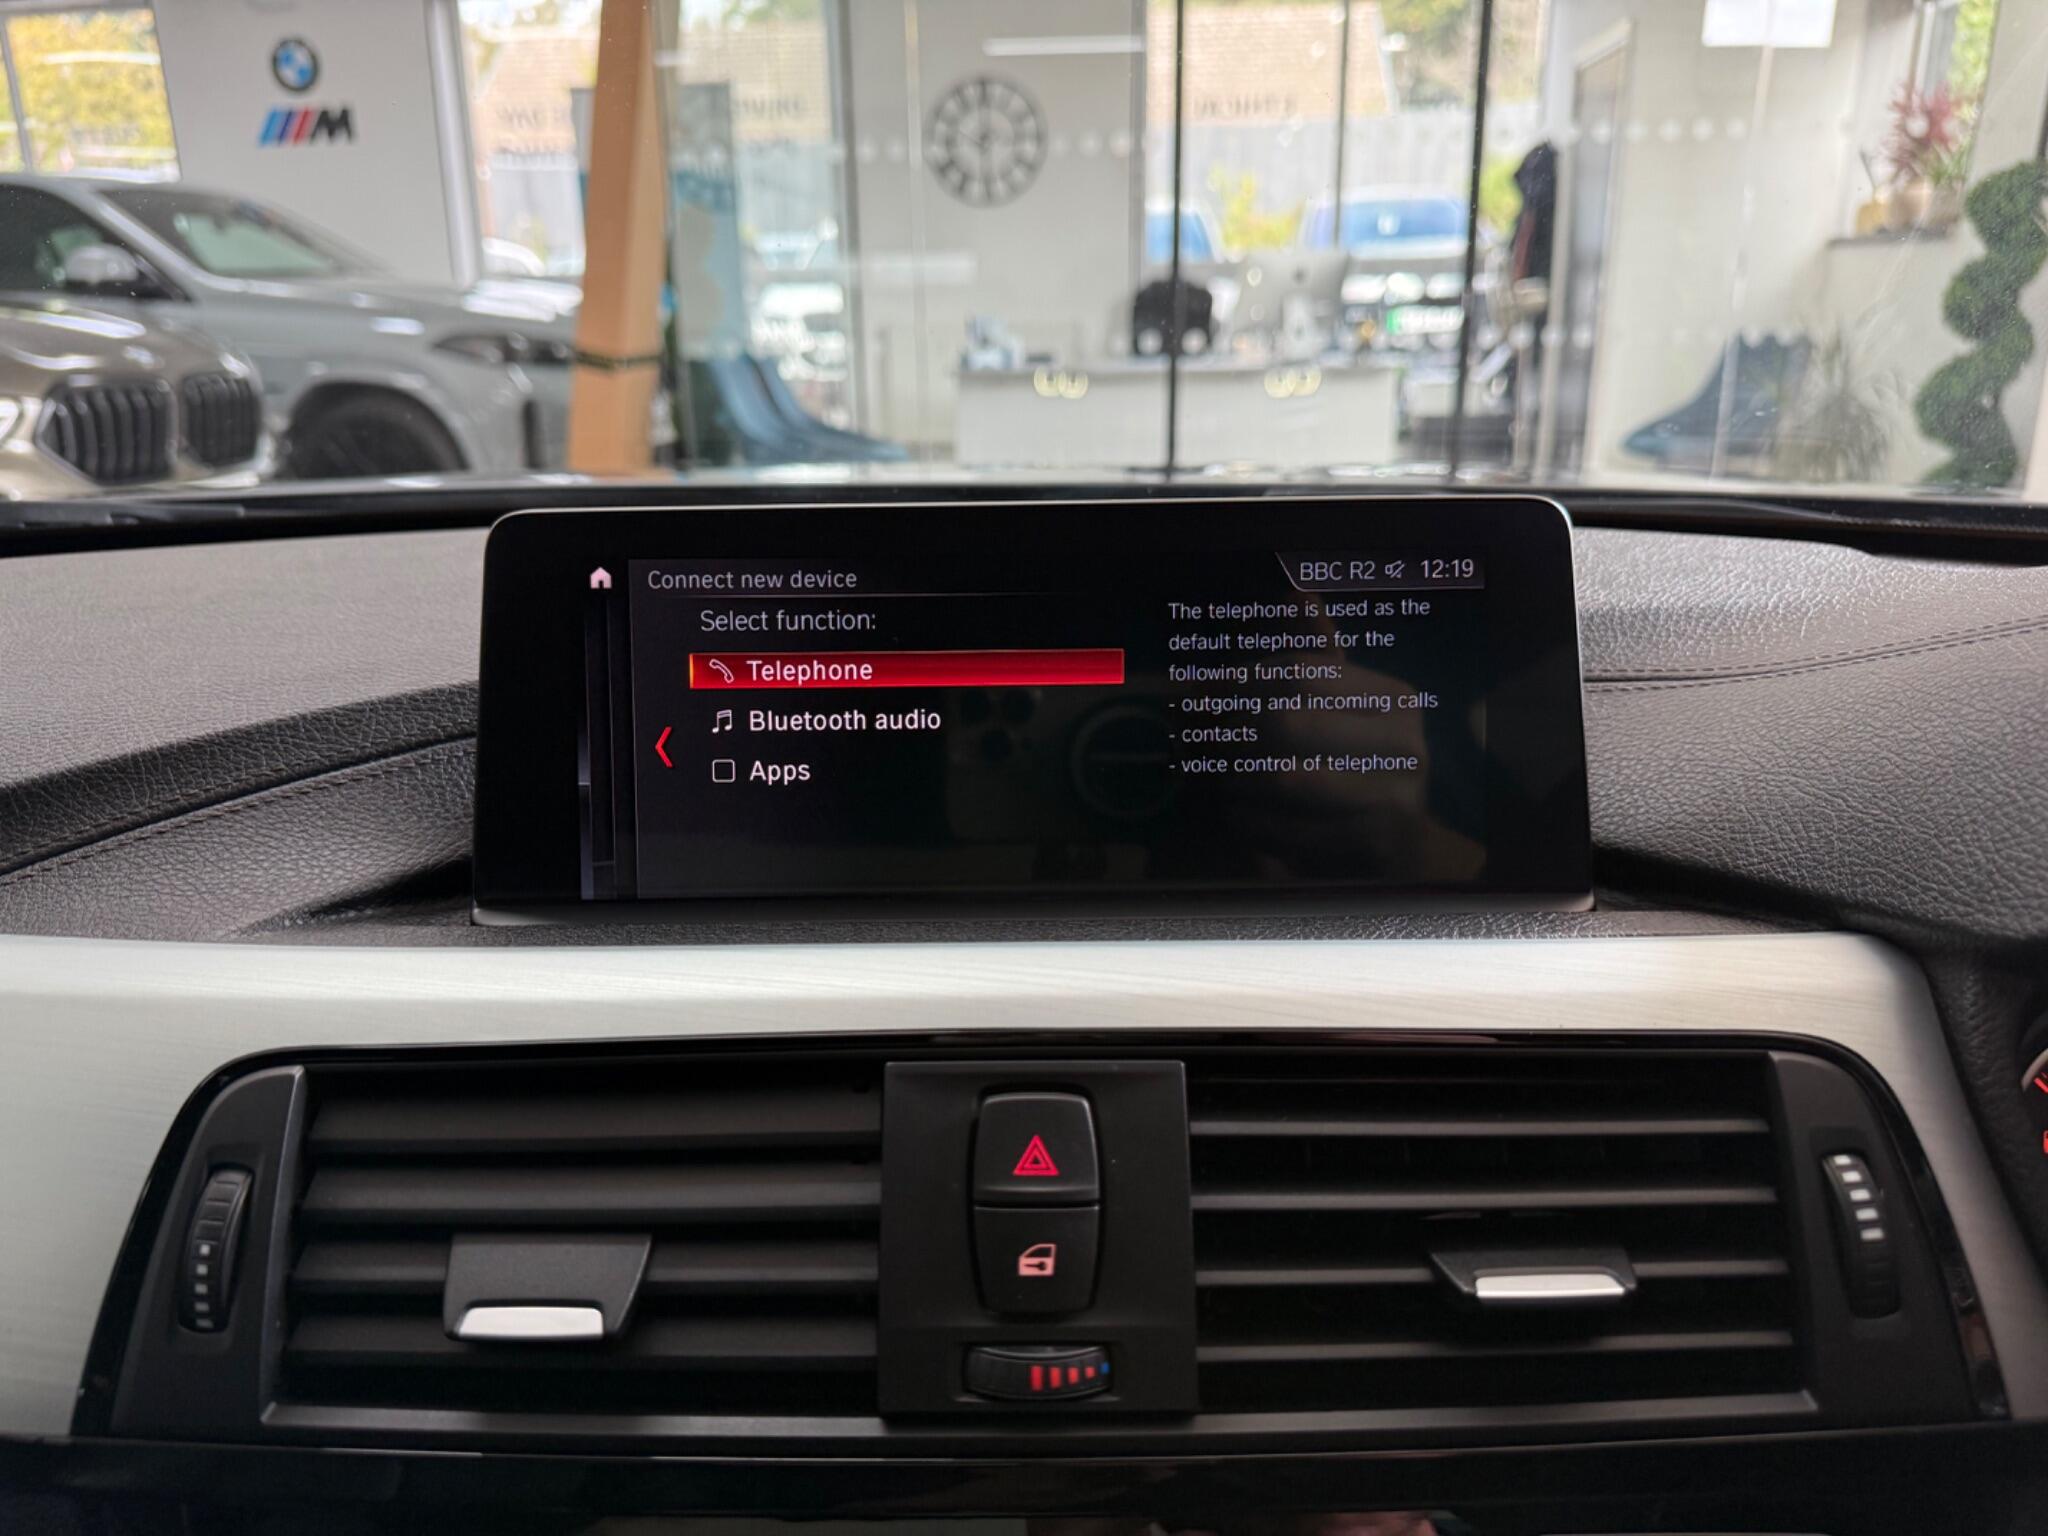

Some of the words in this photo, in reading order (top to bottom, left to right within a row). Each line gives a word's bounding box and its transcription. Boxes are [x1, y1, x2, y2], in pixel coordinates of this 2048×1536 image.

[647, 569, 734, 590] Connect
[741, 573, 784, 589] new
[789, 569, 857, 589] device
[1299, 561, 1343, 582] BBC
[1350, 560, 1376, 580] R2
[1420, 558, 1474, 579] 12:19
[700, 609, 769, 632] Select
[776, 609, 876, 631] function:
[1168, 602, 1202, 620] The
[1208, 601, 1299, 623] telephone
[1304, 600, 1320, 618] is
[1325, 599, 1368, 617] used
[1374, 602, 1395, 616] as
[1400, 598, 1431, 616] the
[1168, 633, 1231, 651] default
[1237, 632, 1328, 652] telephone
[1333, 630, 1360, 648] for
[1365, 630, 1396, 647] the
[746, 659, 873, 686] Telephone
[1168, 663, 1248, 684] following
[1254, 662, 1343, 681] functions:
[1181, 695, 1262, 715] outgoing
[1267, 693, 1301, 711] and
[1307, 692, 1391, 713] incoming
[1397, 691, 1439, 709] calls
[749, 708, 867, 732] Bluetooth
[874, 708, 942, 731] audio
[1181, 725, 1258, 743] contacts
[749, 759, 812, 787] Apps
[1181, 756, 1228, 773] voice
[1234, 755, 1296, 772] control
[1303, 754, 1321, 772] of
[1326, 753, 1418, 774] telephone
